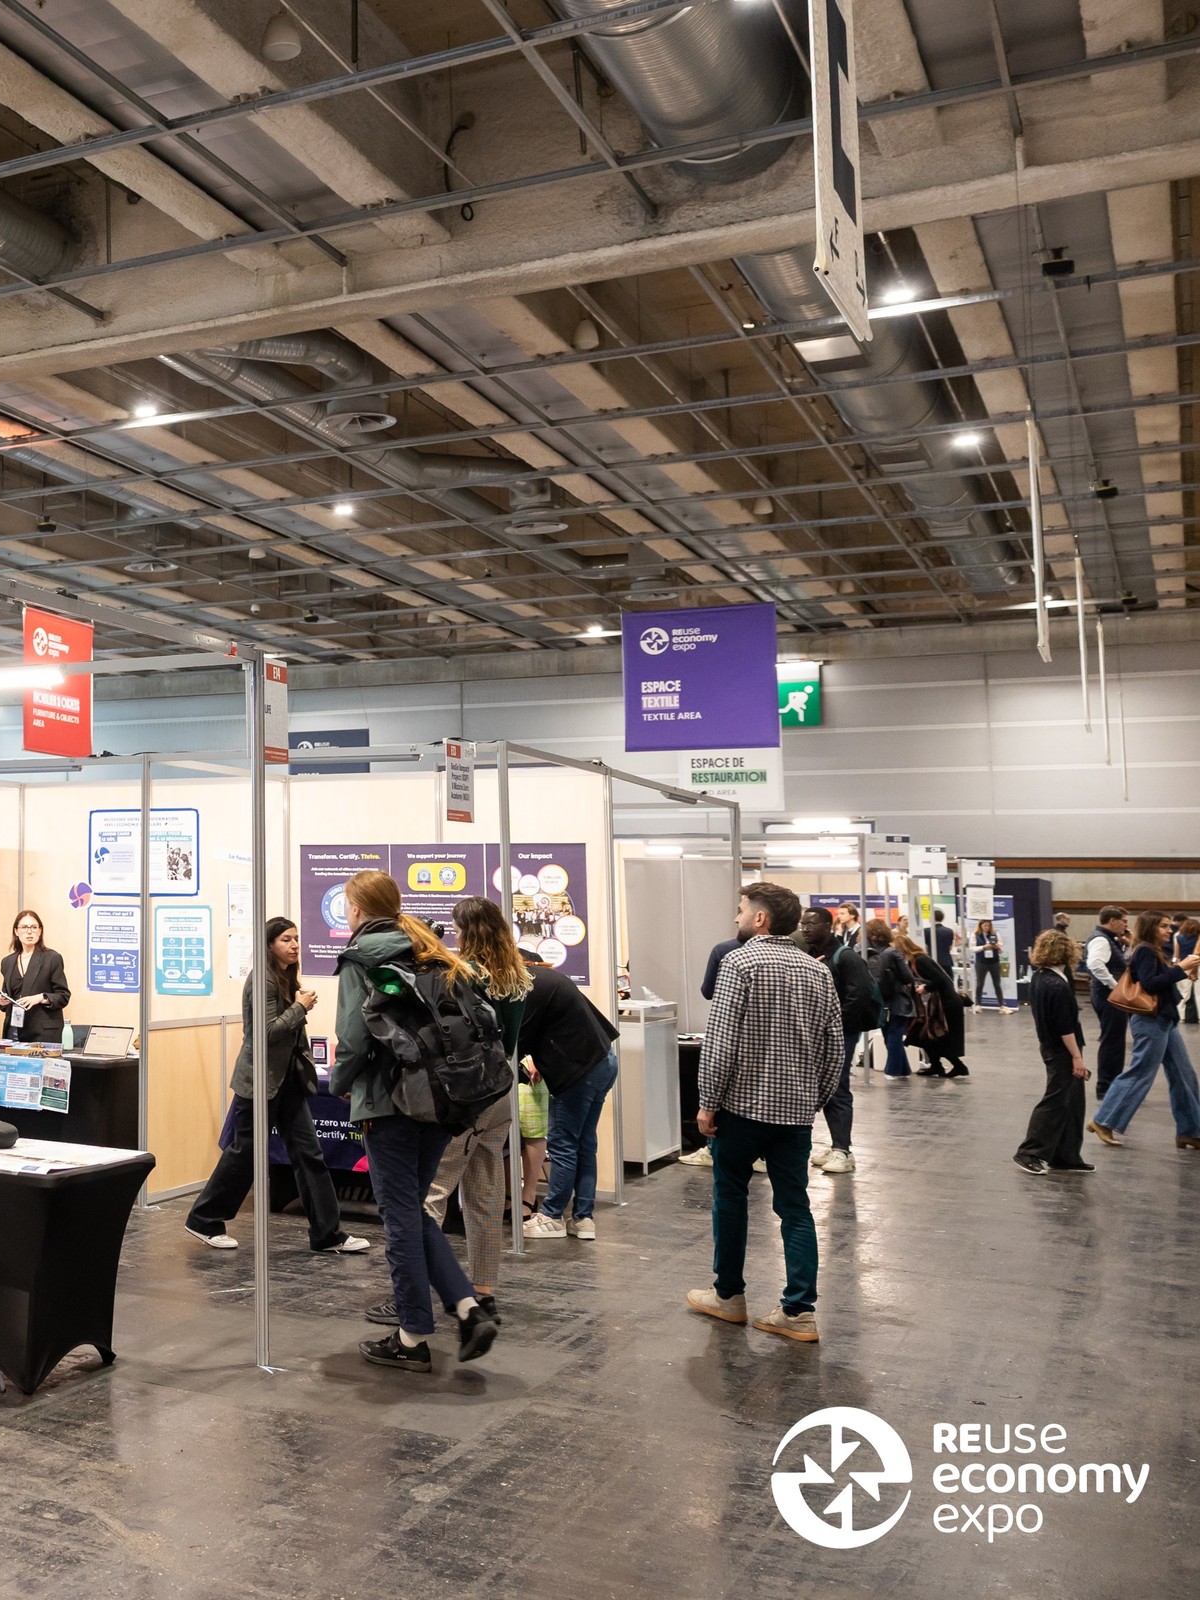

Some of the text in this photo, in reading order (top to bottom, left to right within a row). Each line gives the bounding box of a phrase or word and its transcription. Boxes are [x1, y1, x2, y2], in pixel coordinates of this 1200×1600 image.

[672, 634, 718, 643] economy
[672, 642, 696, 652] expo
[641, 680, 681, 693] ESPACE
[641, 695, 680, 708] TEXTILE
[642, 711, 702, 721] TEXTILE AREA
[691, 757, 744, 769] ESPACE DE
[691, 771, 767, 784] RESTAURATION
[316, 1130, 347, 1141] Certify.
